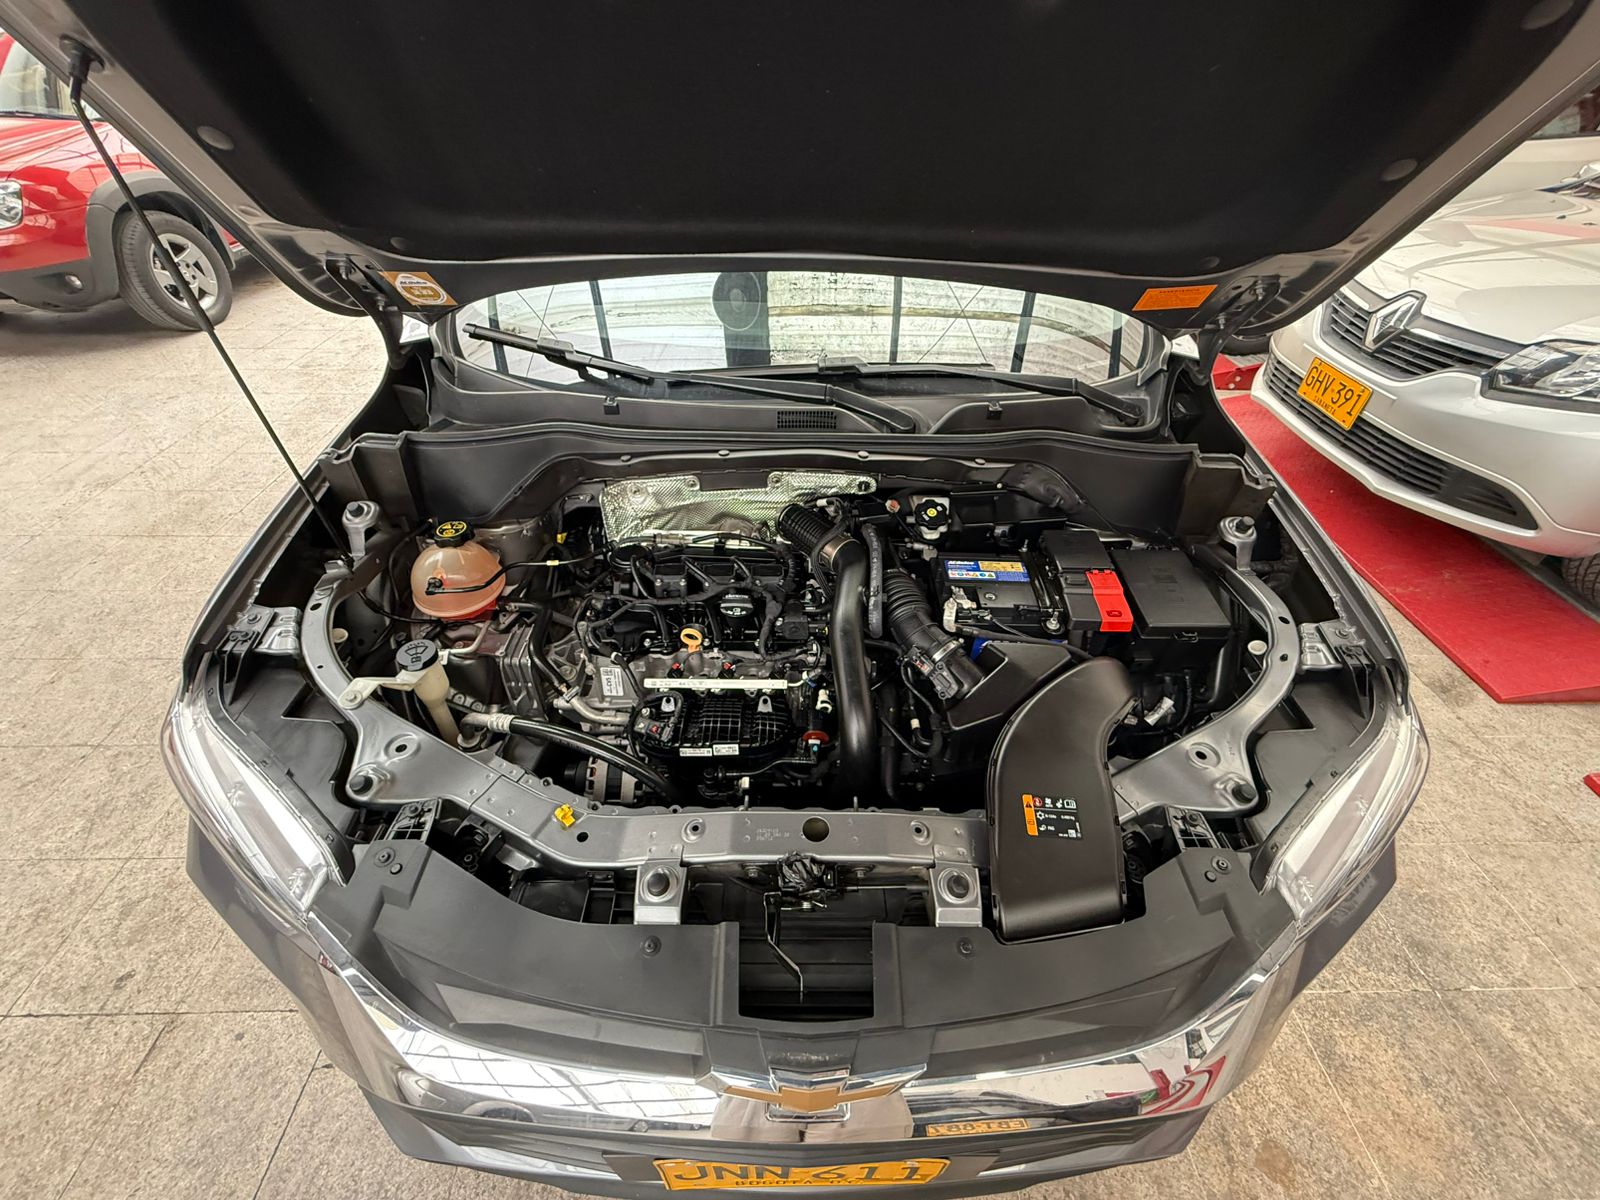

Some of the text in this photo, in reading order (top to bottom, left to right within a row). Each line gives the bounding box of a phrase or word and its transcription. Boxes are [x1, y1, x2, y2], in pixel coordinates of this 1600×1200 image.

[1305, 366, 1361, 416] GHV 391
[675, 1165, 921, 1181] JNN 611
